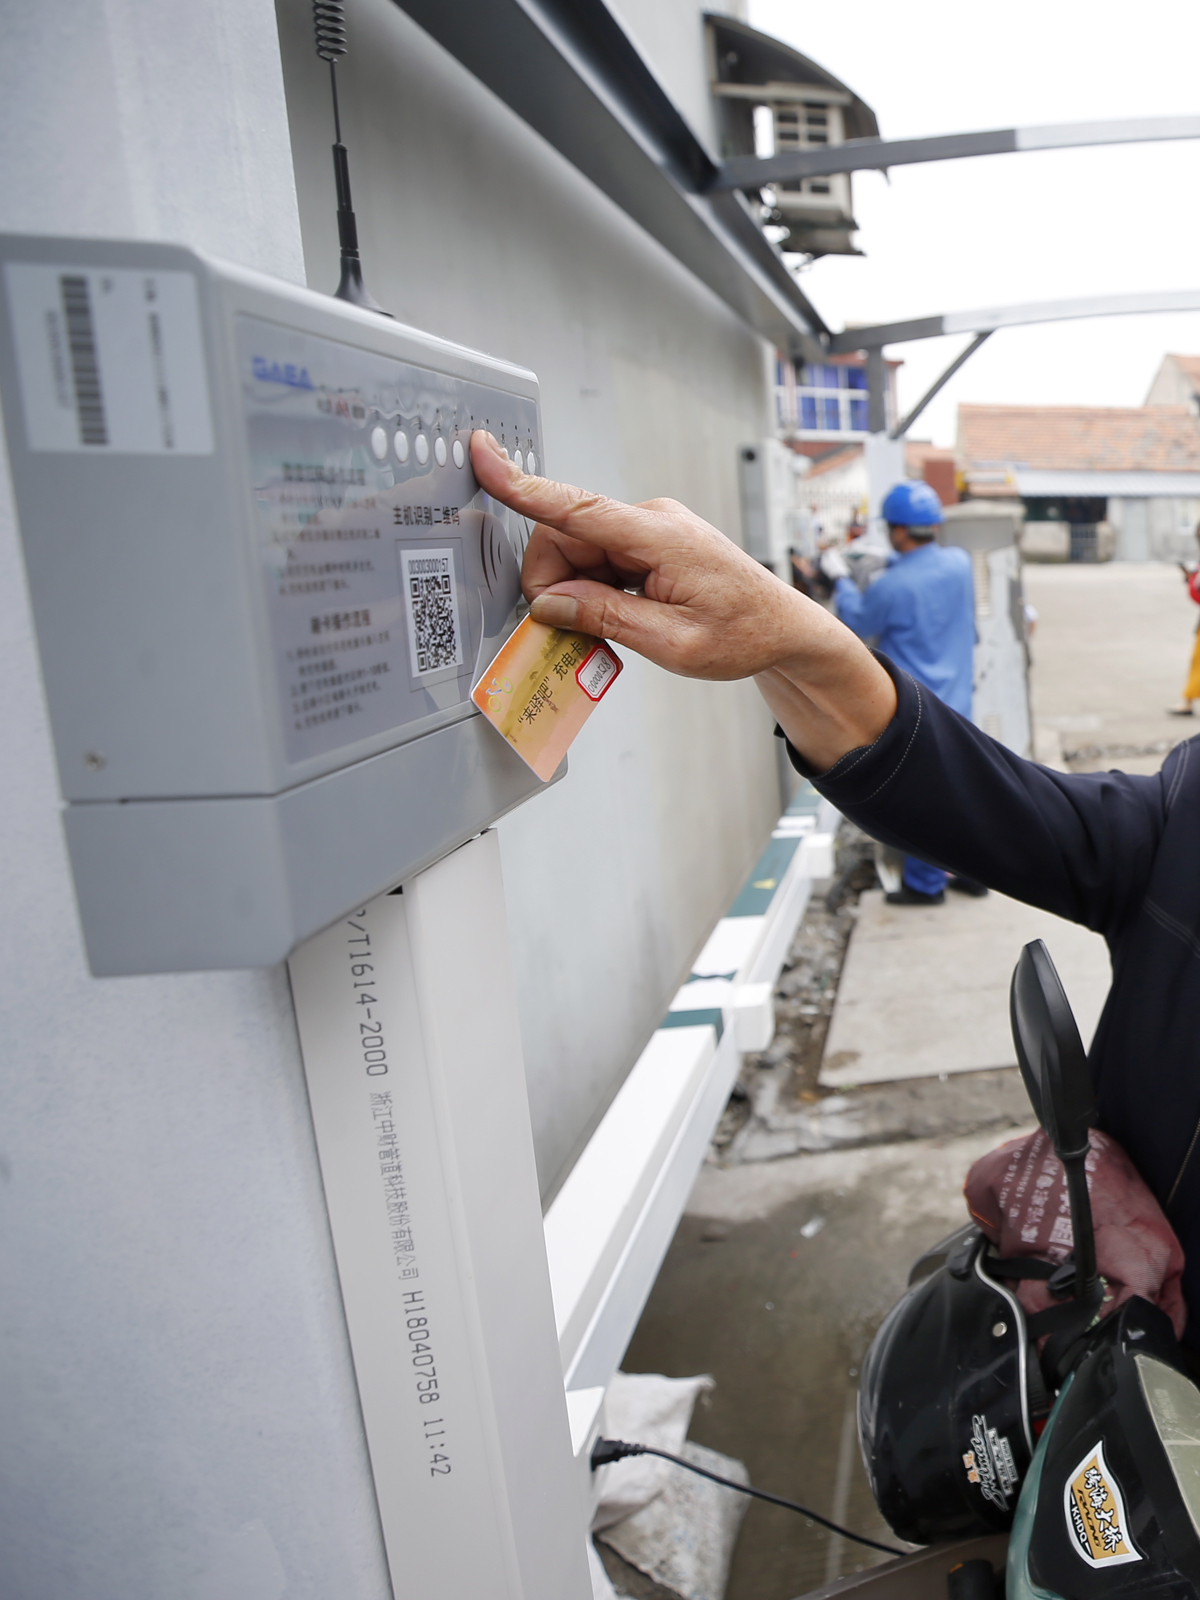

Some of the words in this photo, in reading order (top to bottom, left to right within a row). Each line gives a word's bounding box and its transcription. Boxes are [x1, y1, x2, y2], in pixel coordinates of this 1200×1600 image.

[527, 438, 534, 449] 10
[393, 505, 460, 526] 主机识别二维码
[408, 558, 448, 575] 003003000157
[553, 641, 583, 681] 充电卡
[369, 1091, 419, 1280] 浙江中财管道科技股份有限公司
[402, 1290, 440, 1405] H18040758
[423, 1418, 451, 1477] 11:42
[1071, 1506, 1088, 1544] KHDQ
[1084, 1466, 1123, 1553] 跨海大桥
